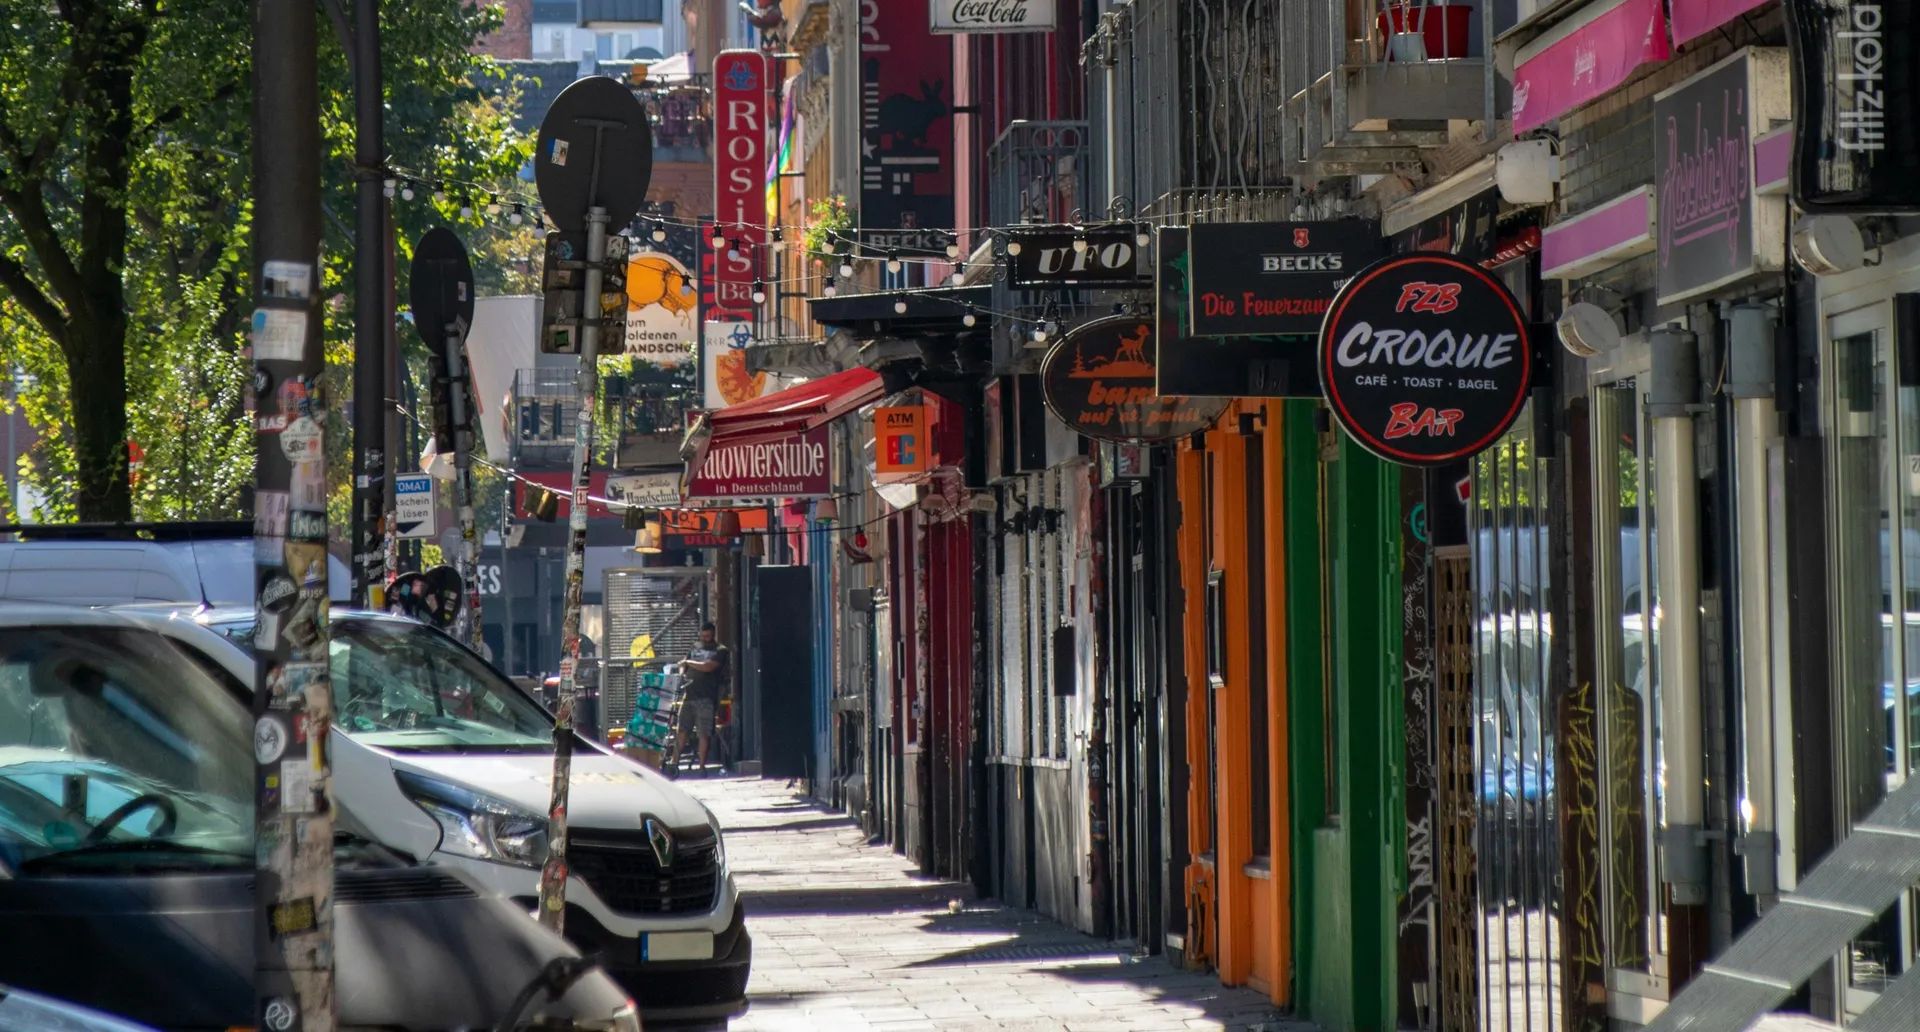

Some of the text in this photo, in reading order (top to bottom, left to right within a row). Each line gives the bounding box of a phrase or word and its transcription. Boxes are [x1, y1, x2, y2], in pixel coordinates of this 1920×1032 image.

[1838, 4, 1884, 153] fritz-kola
[1038, 242, 1132, 274] UFO
[1263, 253, 1343, 271] BECK'S
[1202, 292, 1236, 317] Die
[1396, 282, 1461, 314] FZB
[627, 332, 677, 340] oldenen
[1337, 322, 1518, 369] CROQUE
[1355, 374, 1498, 390] CAFÉ TOAST BAGEL
[887, 413, 914, 424] ATM
[1079, 408, 1114, 426] auf
[1384, 402, 1464, 439] BAR
[716, 481, 803, 494] in Deutschland
